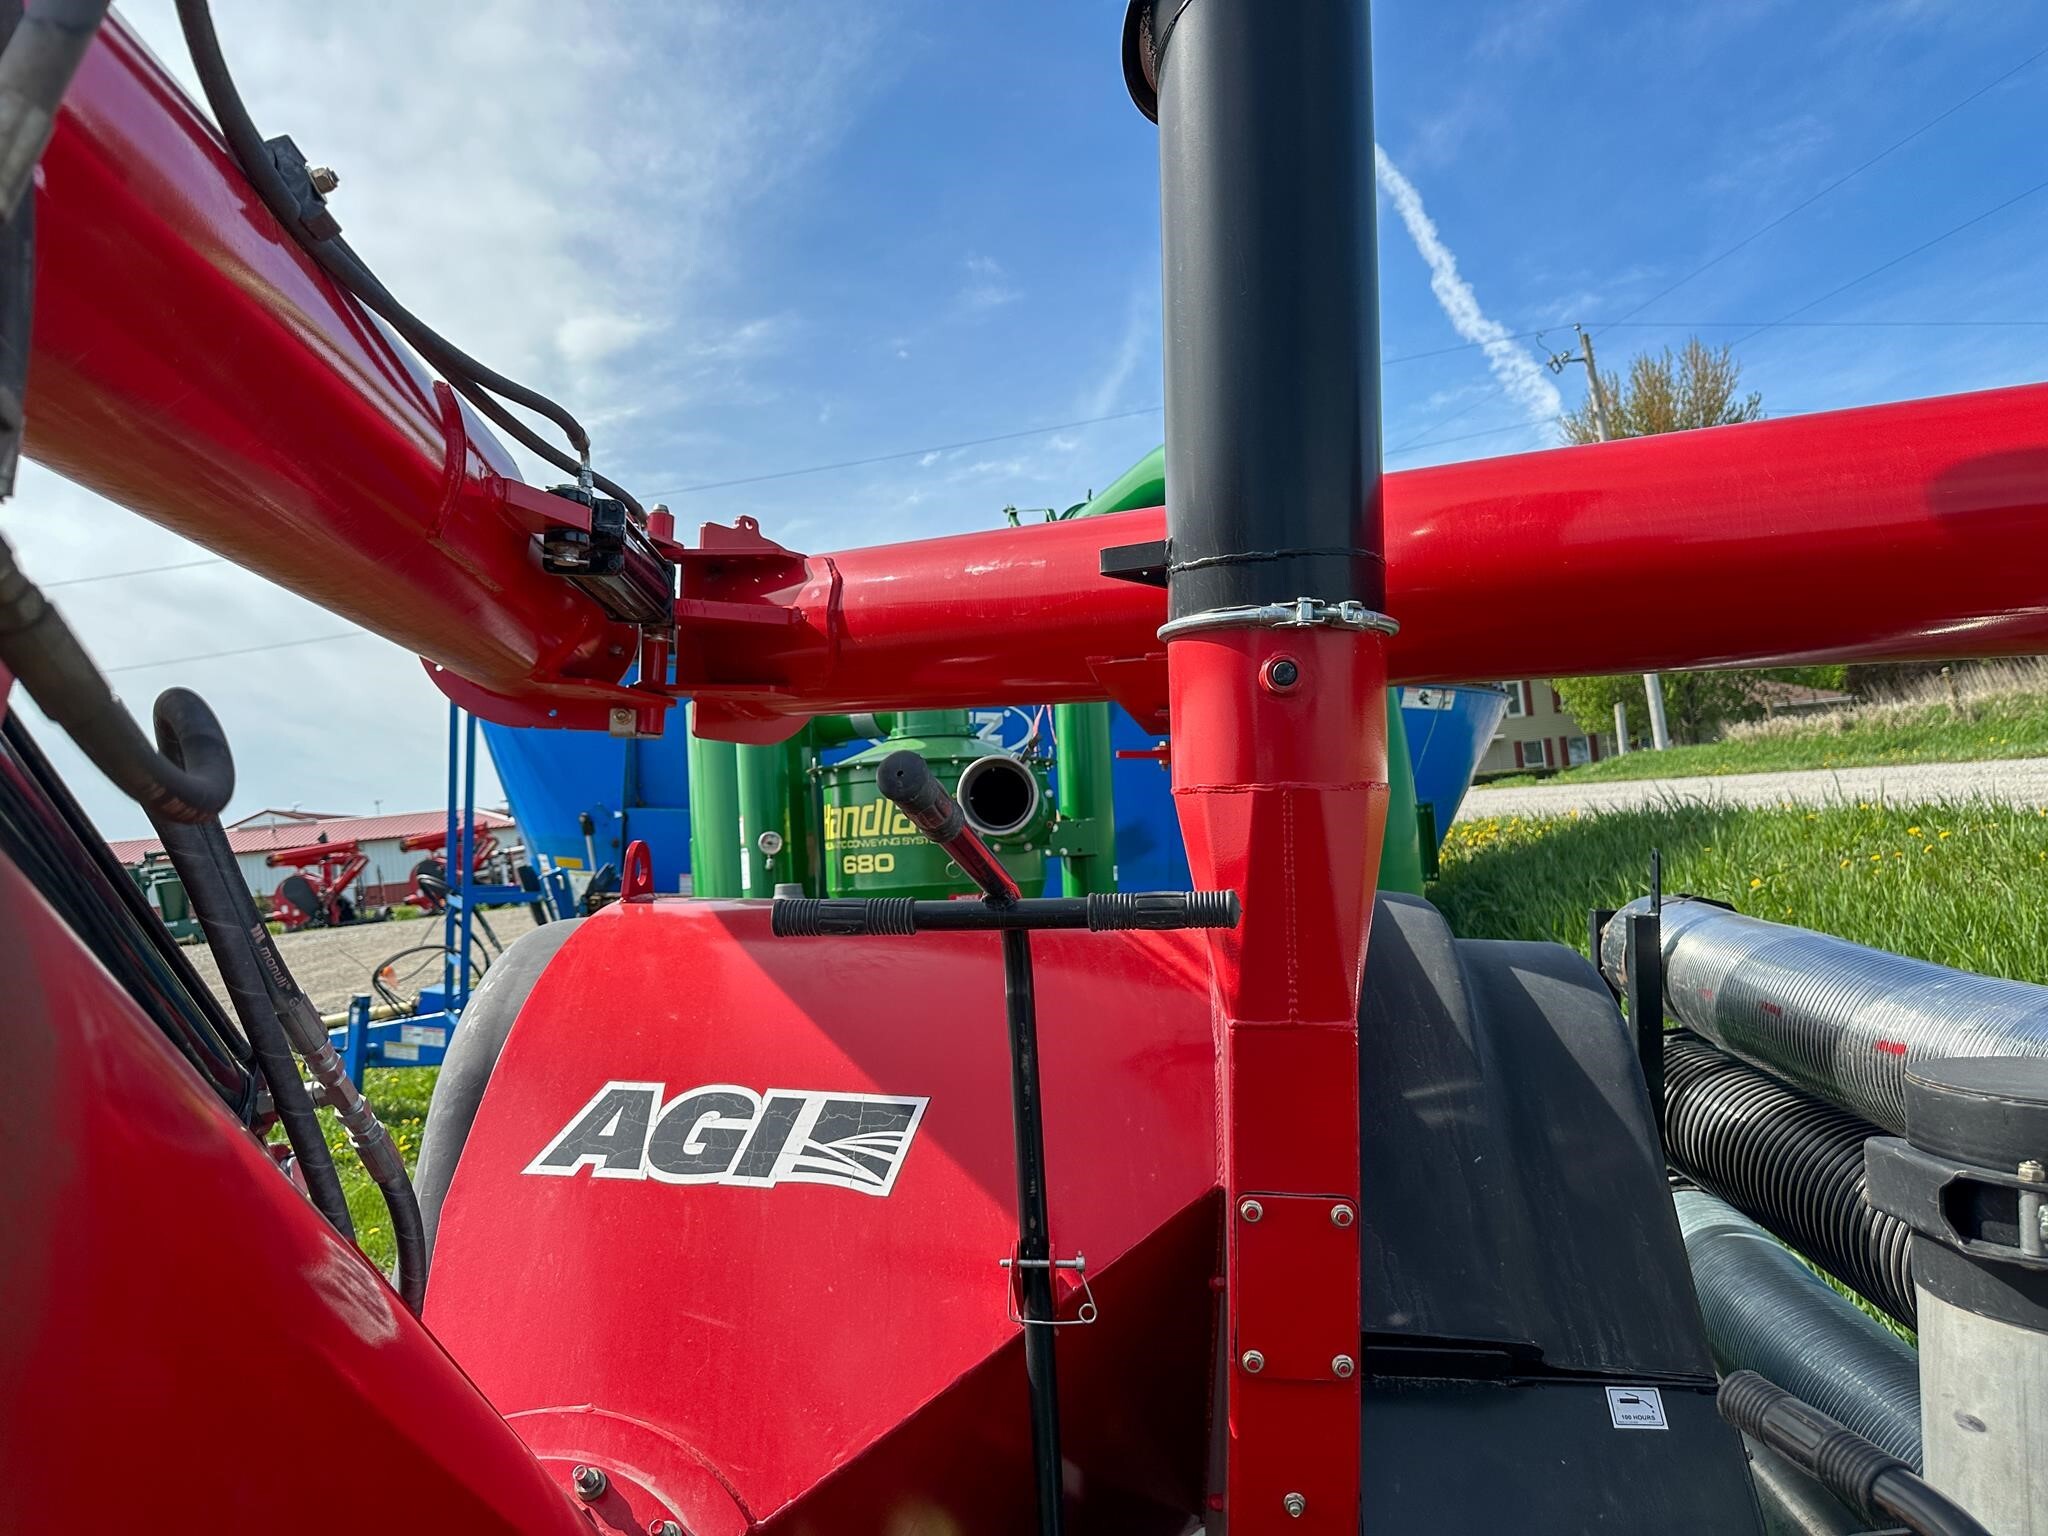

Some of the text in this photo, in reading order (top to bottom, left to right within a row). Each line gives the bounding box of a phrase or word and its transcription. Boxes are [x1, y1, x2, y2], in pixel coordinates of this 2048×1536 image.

[848, 837, 900, 849] CONVEYING
[843, 853, 895, 875] 680
[526, 1083, 808, 1184] AGI
